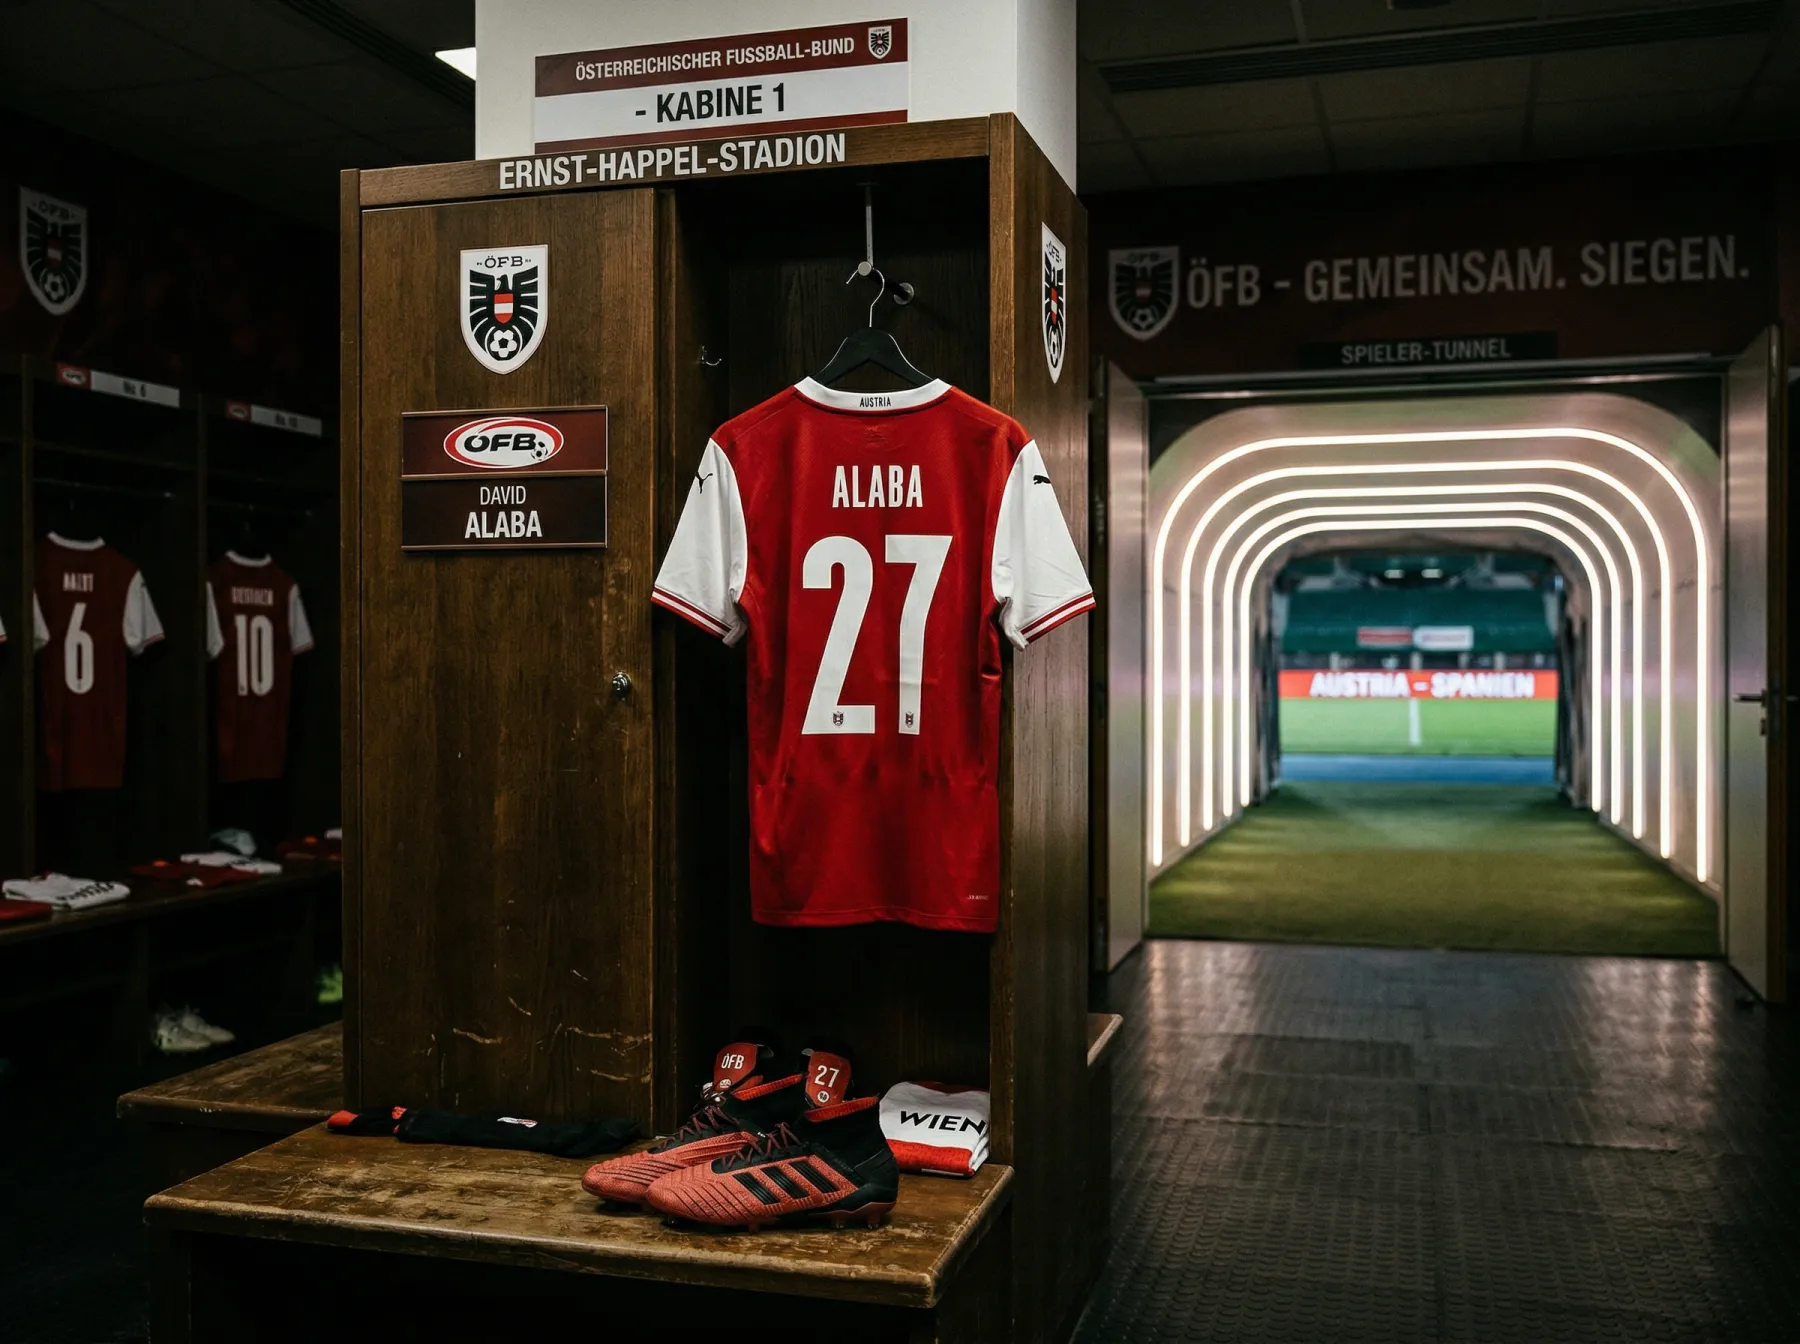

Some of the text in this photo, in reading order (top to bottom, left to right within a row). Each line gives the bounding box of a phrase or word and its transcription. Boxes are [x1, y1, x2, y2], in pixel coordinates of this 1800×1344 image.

[575, 37, 855, 81] ÖSTERREICHISCHER FUSSBALL-BUND
[656, 84, 763, 123] KABINE
[773, 82, 786, 112] 1
[499, 132, 846, 190] ERNST-HAPPEL-STADION
[484, 255, 523, 269] ÖFB
[1186, 257, 1261, 309] ÖFB
[1304, 246, 1566, 303] GEMEINSAM.
[1579, 235, 1750, 288] SIEGEN.
[1341, 338, 1512, 366] SPIELER-TUNNEL
[859, 396, 892, 408] AUSTRIA
[479, 485, 527, 506] DAVID
[832, 465, 924, 509] ALABA
[464, 510, 543, 539] ALABA
[64, 602, 95, 695] 6
[801, 534, 954, 736] 27
[235, 614, 275, 698] 10
[1310, 673, 1410, 697] AUSTRIA
[1432, 673, 1535, 697] SPANIEN
[814, 1065, 840, 1088] 27
[900, 1111, 987, 1136] WIEN
